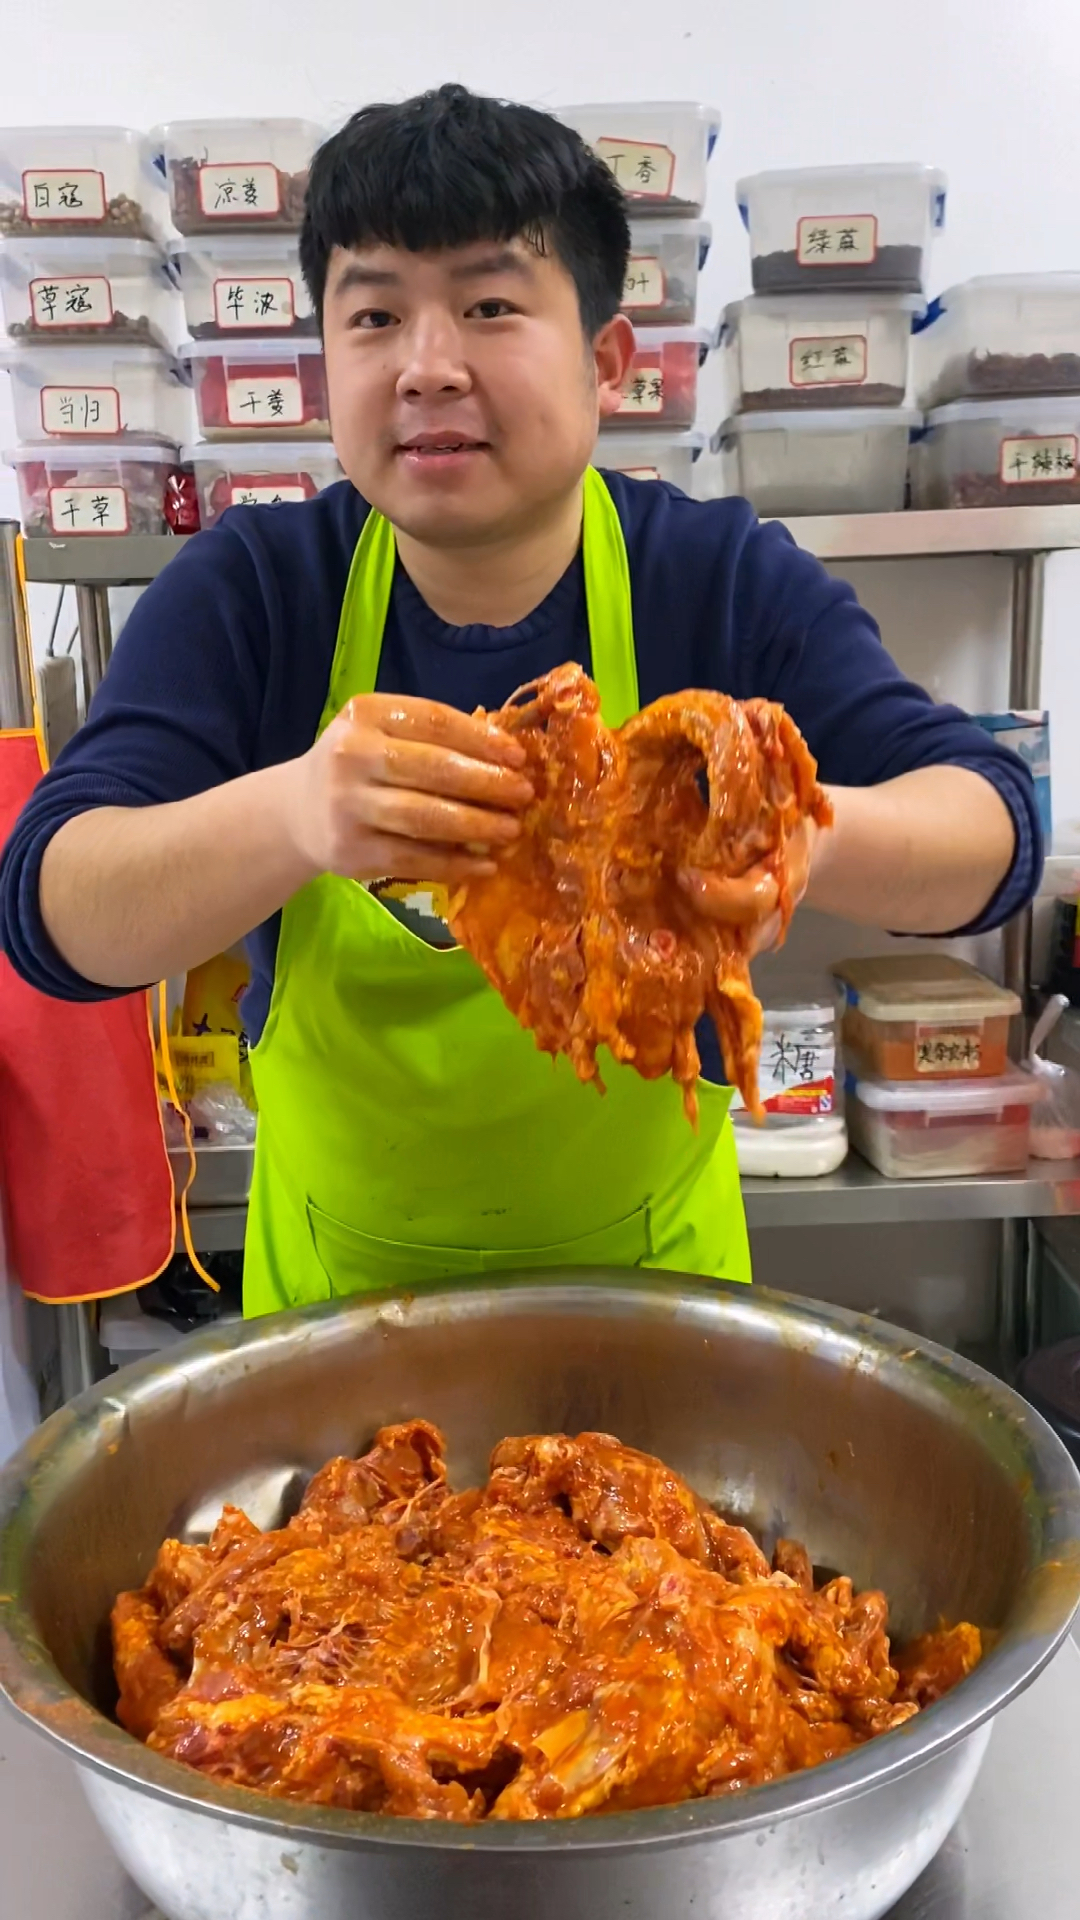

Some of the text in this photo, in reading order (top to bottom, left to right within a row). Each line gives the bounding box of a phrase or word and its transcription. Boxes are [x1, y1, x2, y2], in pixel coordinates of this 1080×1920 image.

[606, 154, 656, 183] 丁香
[59, 394, 100, 428] 当归
[61, 495, 109, 527] 干草
